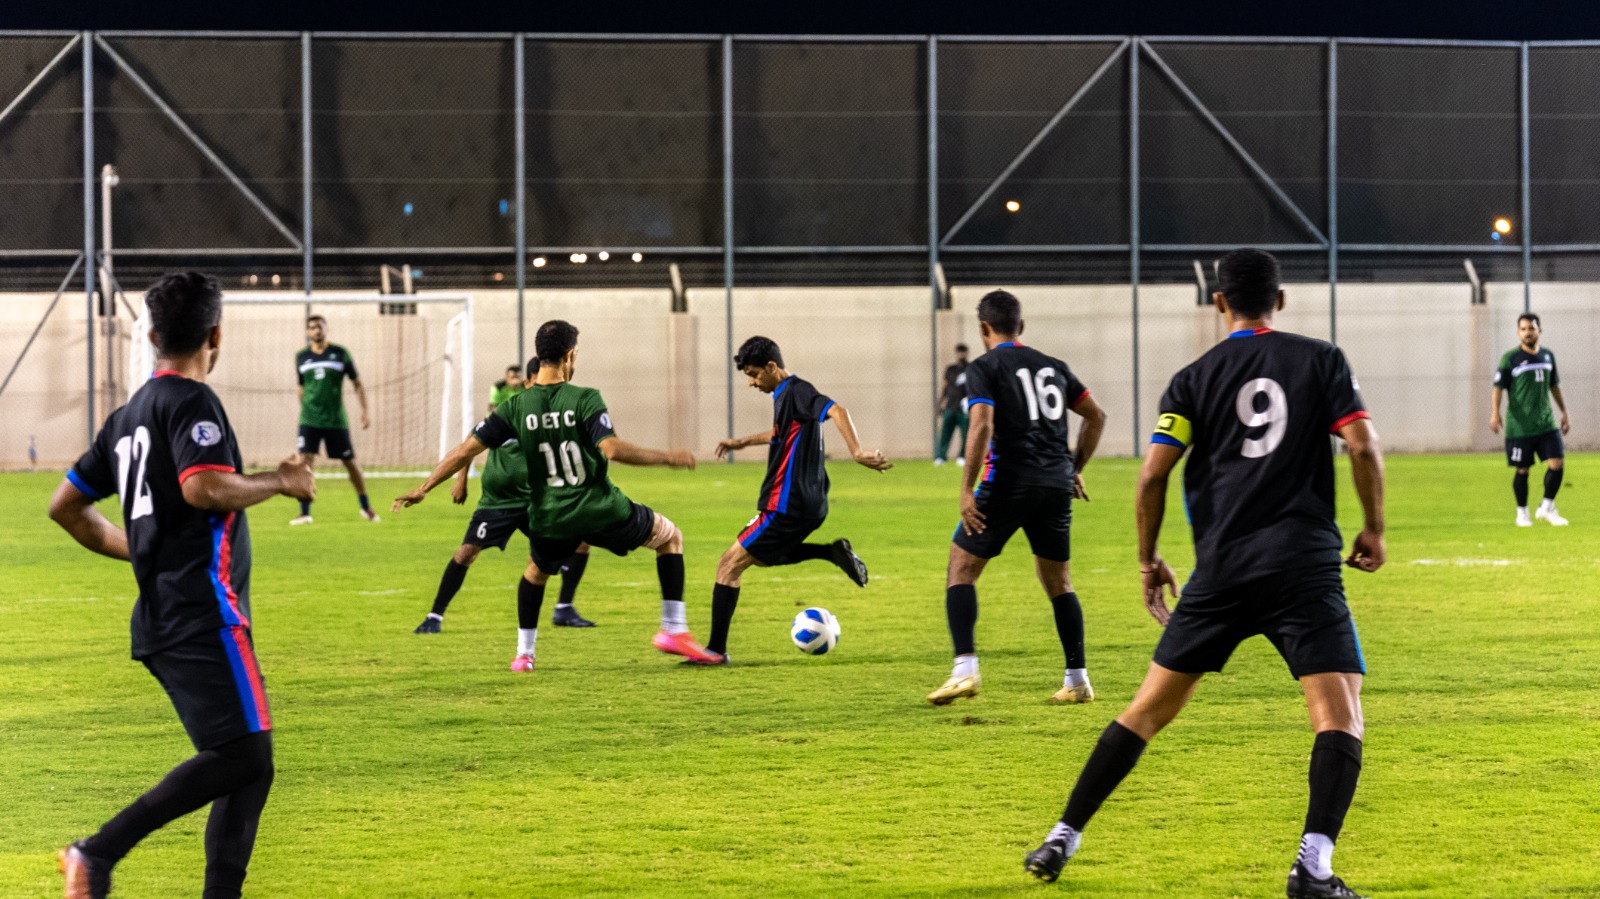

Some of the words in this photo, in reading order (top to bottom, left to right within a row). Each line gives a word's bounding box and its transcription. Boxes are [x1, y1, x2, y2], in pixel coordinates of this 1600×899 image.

[1016, 367, 1064, 420] 16
[1535, 368, 1544, 382] 11
[1235, 377, 1288, 458] 9
[114, 425, 153, 520] 12
[539, 440, 586, 487] 10
[1511, 447, 1522, 462] 11
[476, 522, 488, 539] 6
